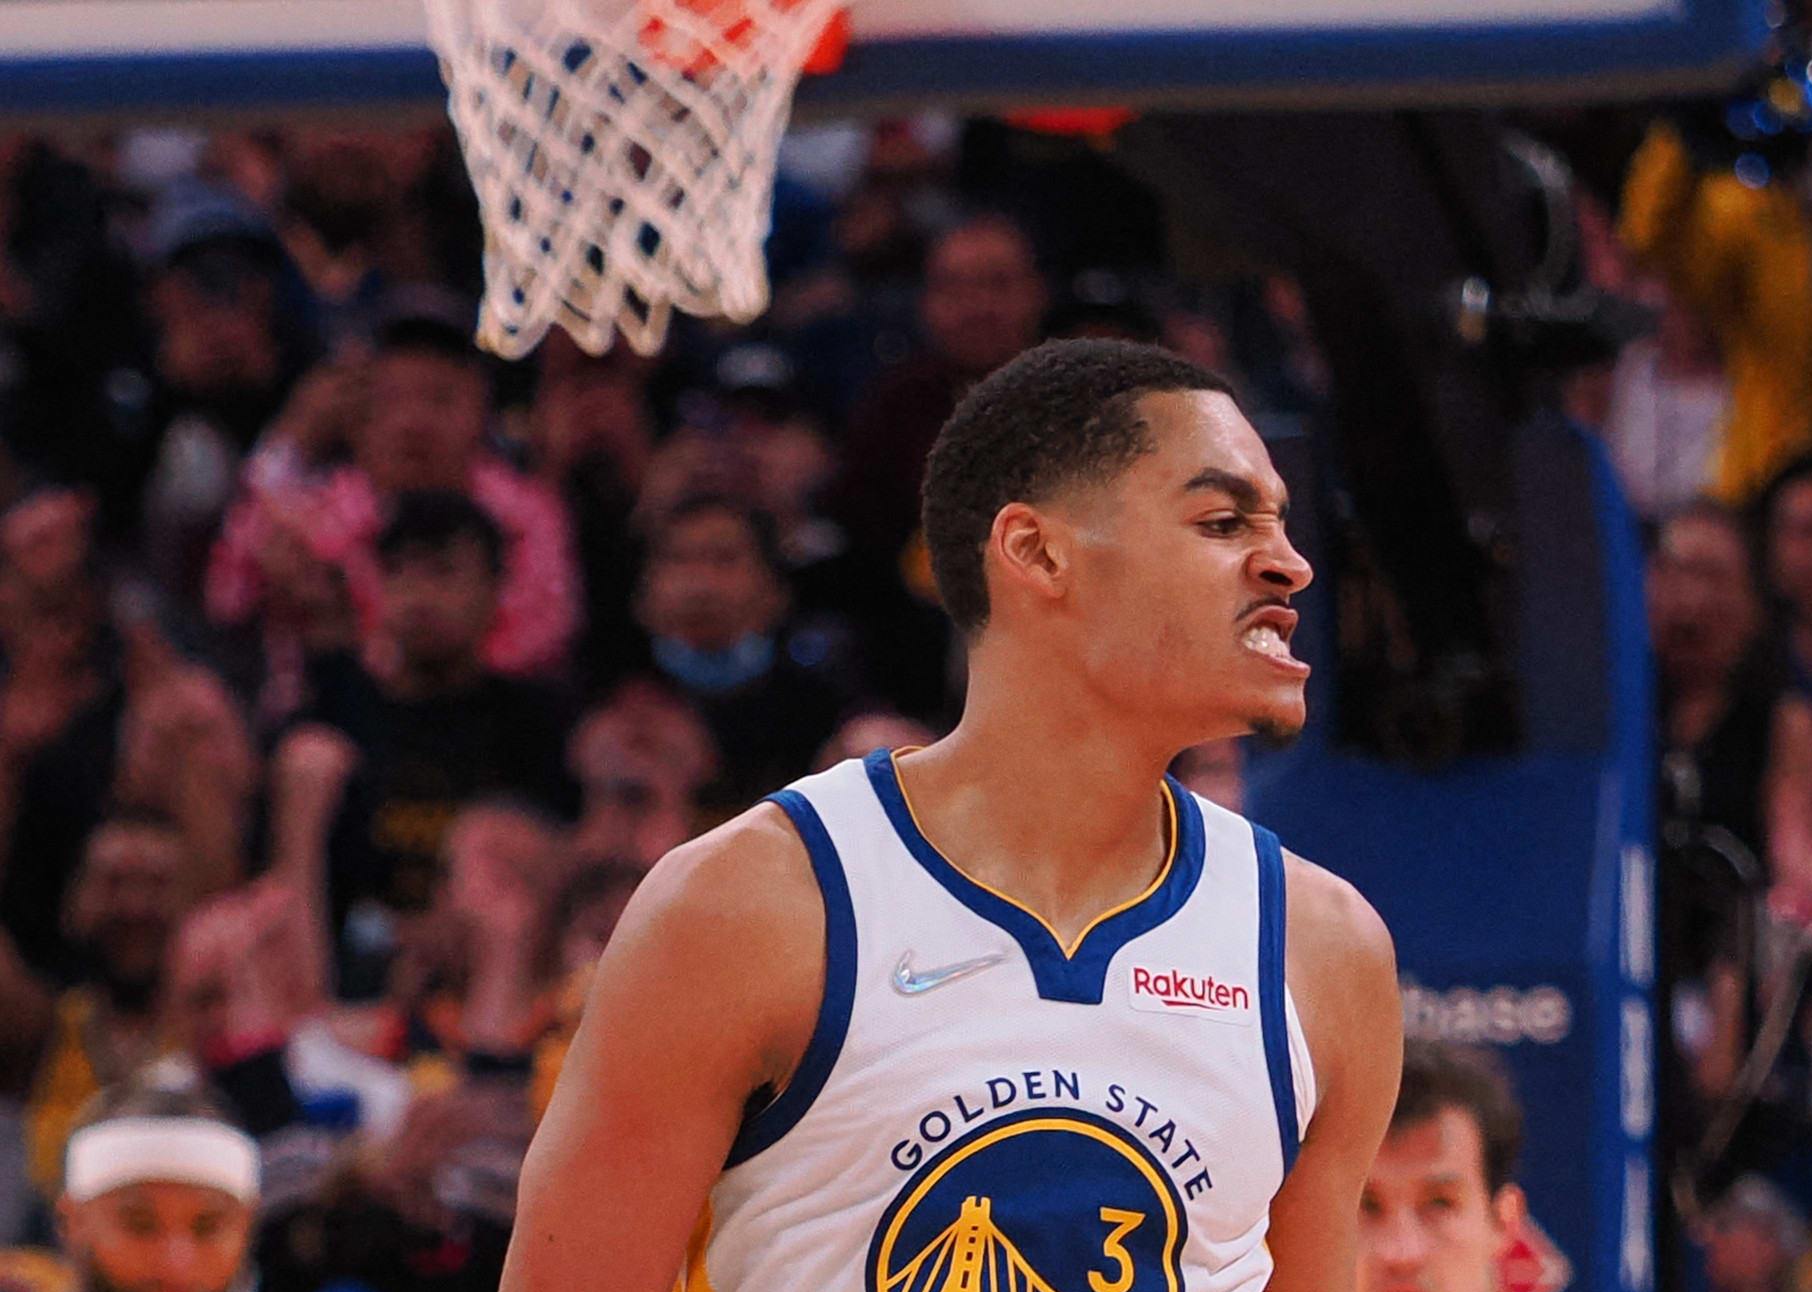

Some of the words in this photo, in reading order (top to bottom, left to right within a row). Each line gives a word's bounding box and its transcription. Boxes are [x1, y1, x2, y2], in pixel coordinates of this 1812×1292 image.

[1132, 967, 1249, 1010] Rakuten
[890, 1069, 1080, 1171] GOLDEN
[1105, 1083, 1213, 1201] STATE
